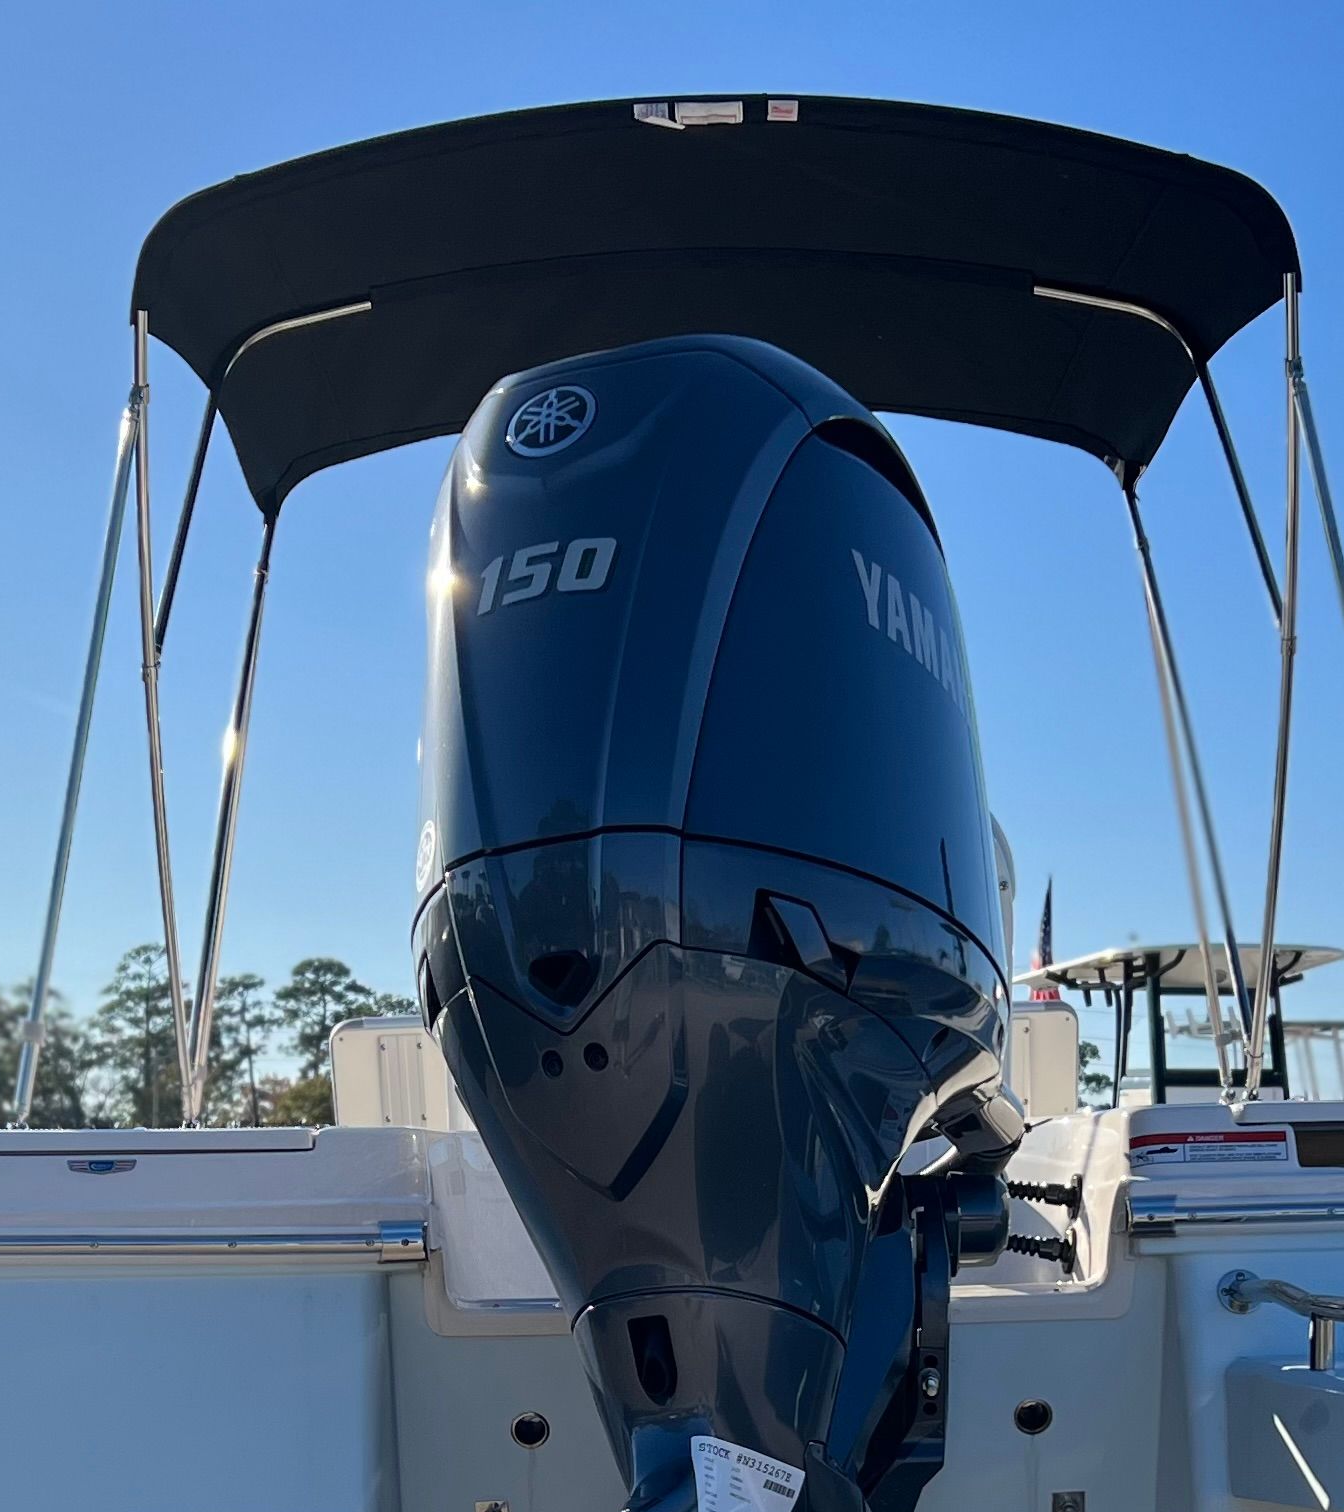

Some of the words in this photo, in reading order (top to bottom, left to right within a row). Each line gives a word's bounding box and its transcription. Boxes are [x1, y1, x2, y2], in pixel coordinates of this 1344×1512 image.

[477, 537, 617, 616] 150
[698, 1442, 731, 1460] STOCK
[736, 1453, 792, 1483] #N315267E
